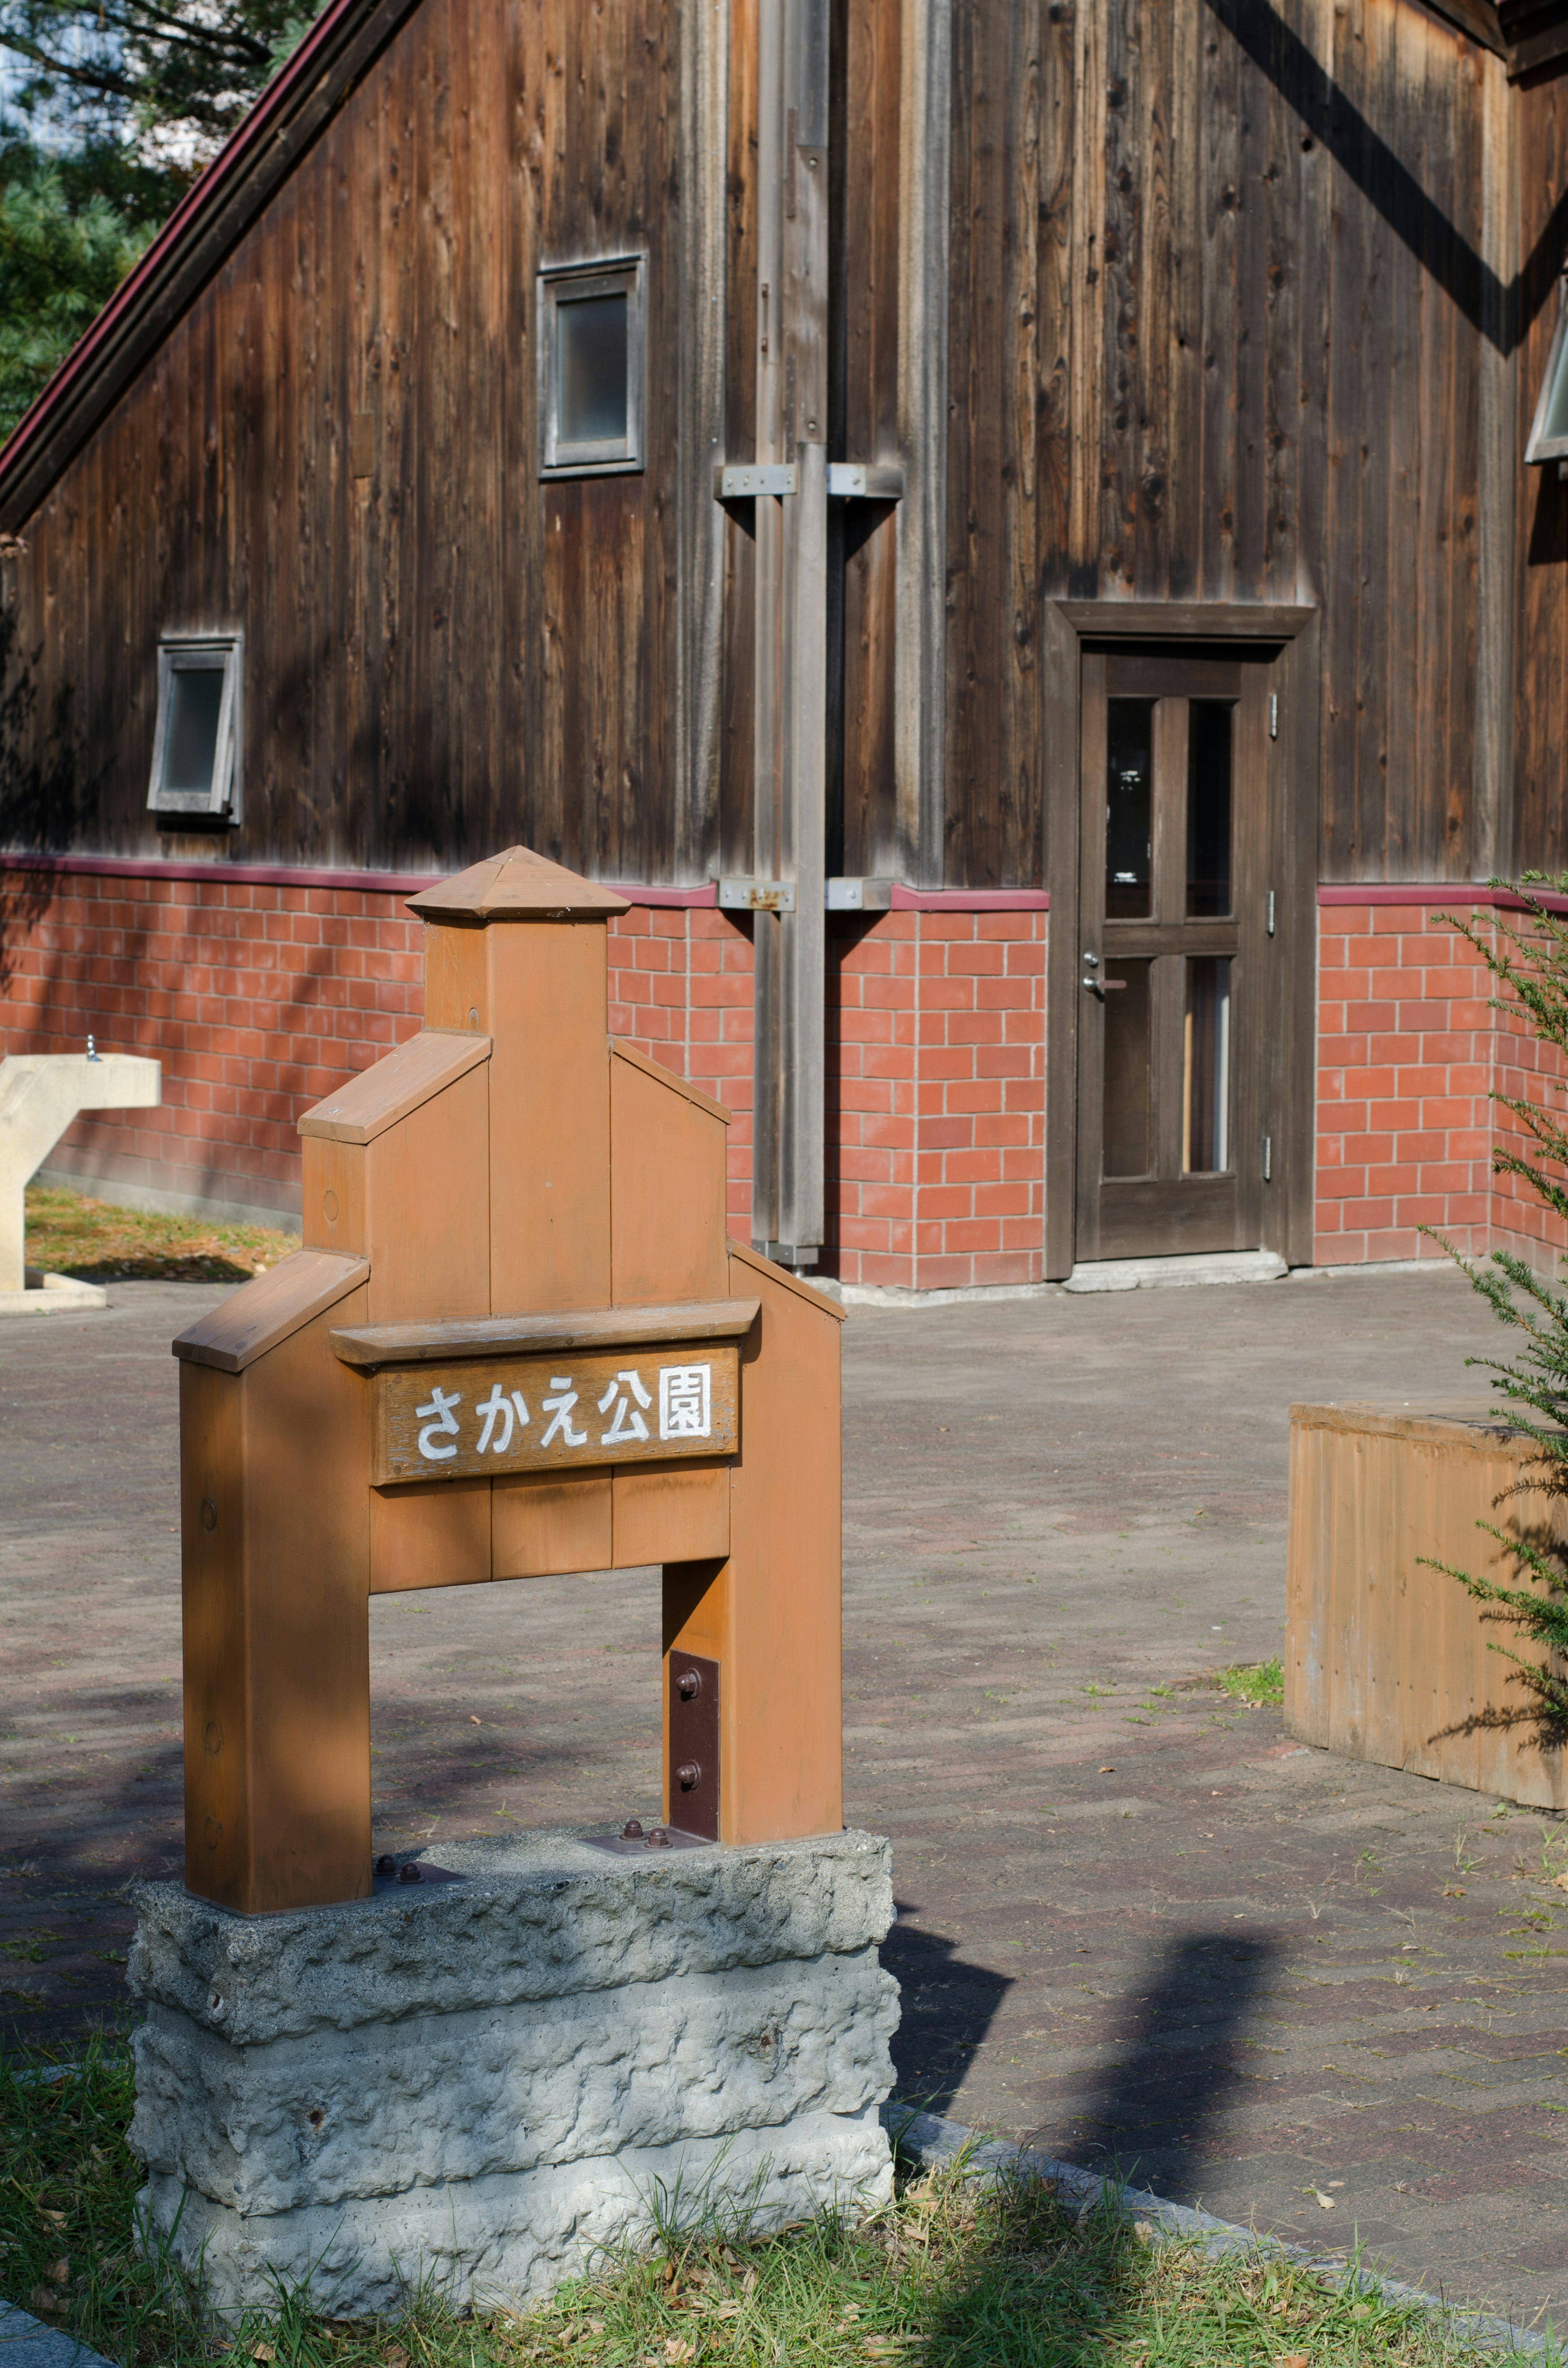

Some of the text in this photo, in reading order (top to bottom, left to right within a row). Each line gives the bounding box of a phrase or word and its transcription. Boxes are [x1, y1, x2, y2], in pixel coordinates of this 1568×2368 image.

[415, 1362, 711, 1460] さかえ公園
